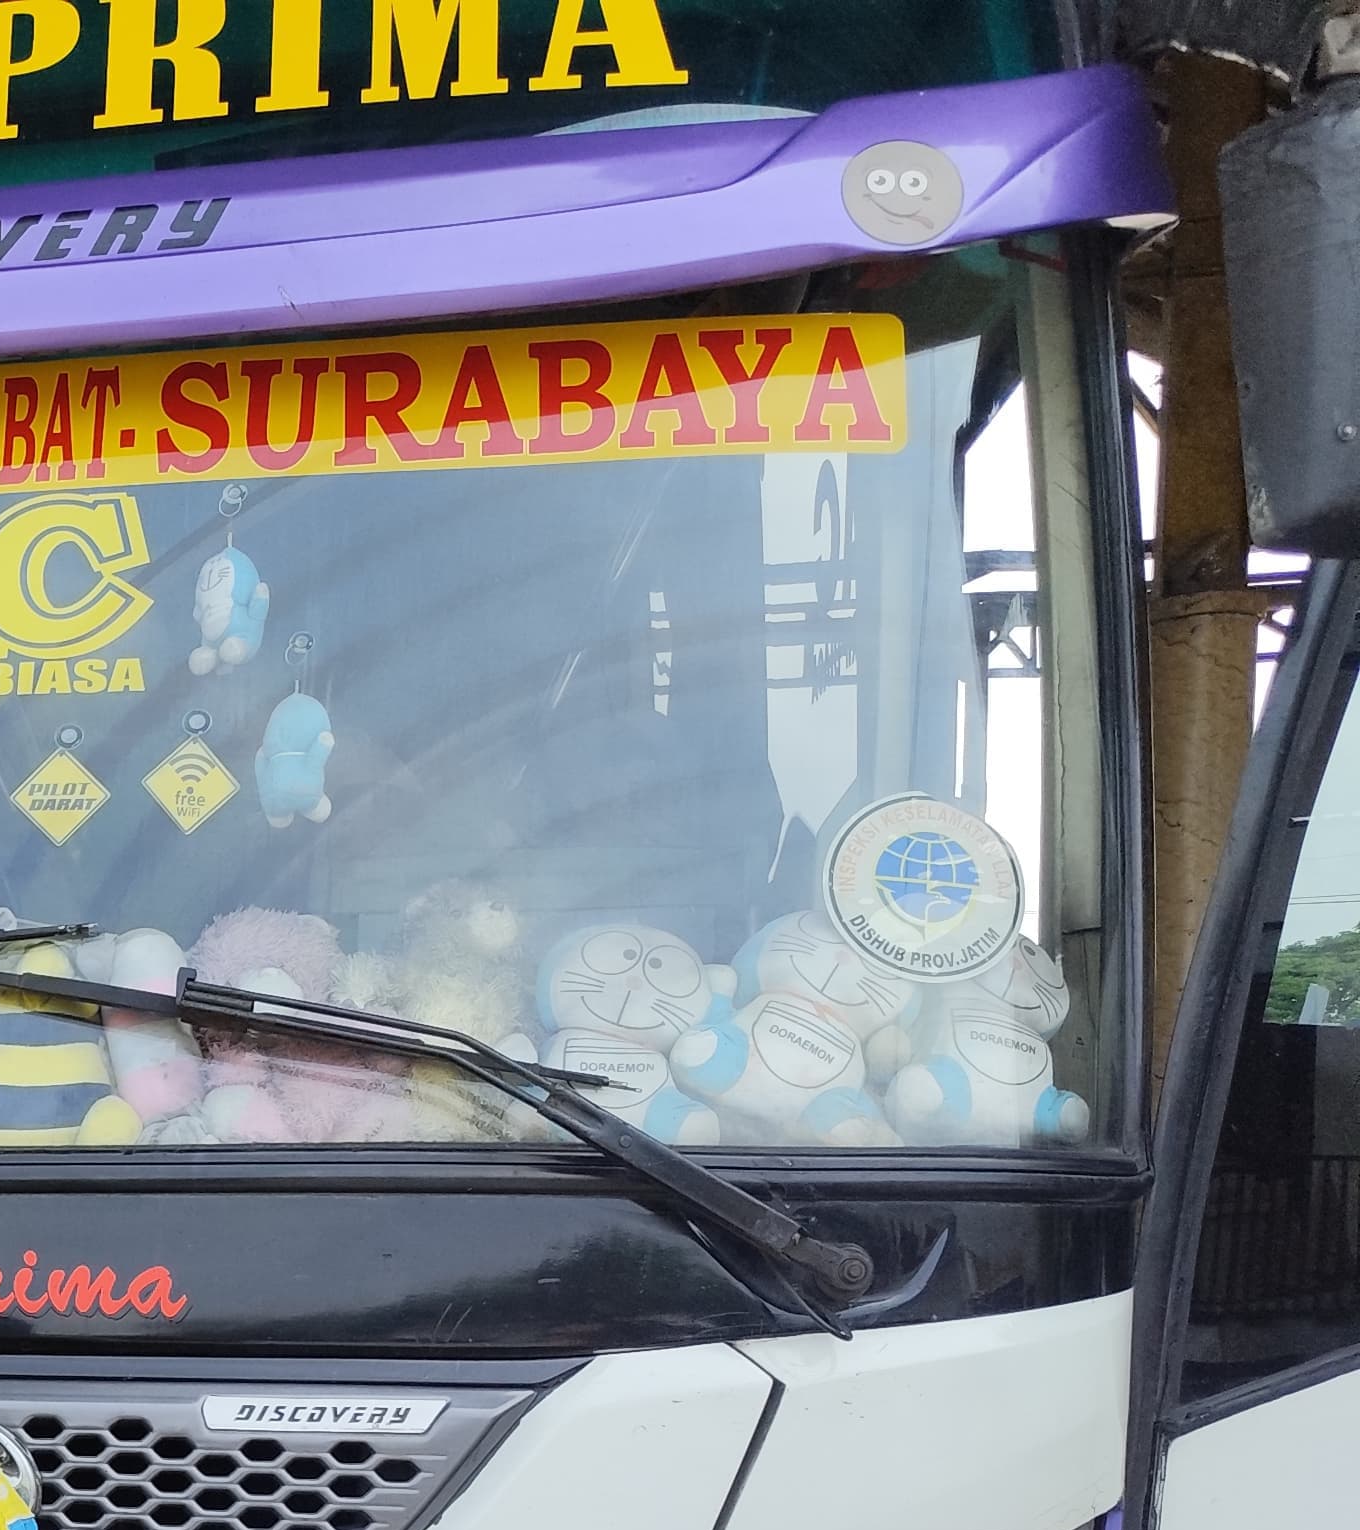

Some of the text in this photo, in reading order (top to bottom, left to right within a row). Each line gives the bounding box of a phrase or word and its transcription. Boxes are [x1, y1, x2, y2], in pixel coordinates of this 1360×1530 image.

[28, 782, 91, 797] PILOT
[175, 790, 206, 807] free
[29, 798, 98, 812] DARAT
[838, 819, 881, 893] INSPEKSI
[881, 804, 999, 857] KESELAMATAN
[849, 914, 906, 963] DISHUB
[768, 1024, 835, 1065] DORAEMON
[969, 1030, 1037, 1055] DORAEMON
[579, 1062, 655, 1073] DORAEMON
[233, 1401, 412, 1425] DISCOVERY
